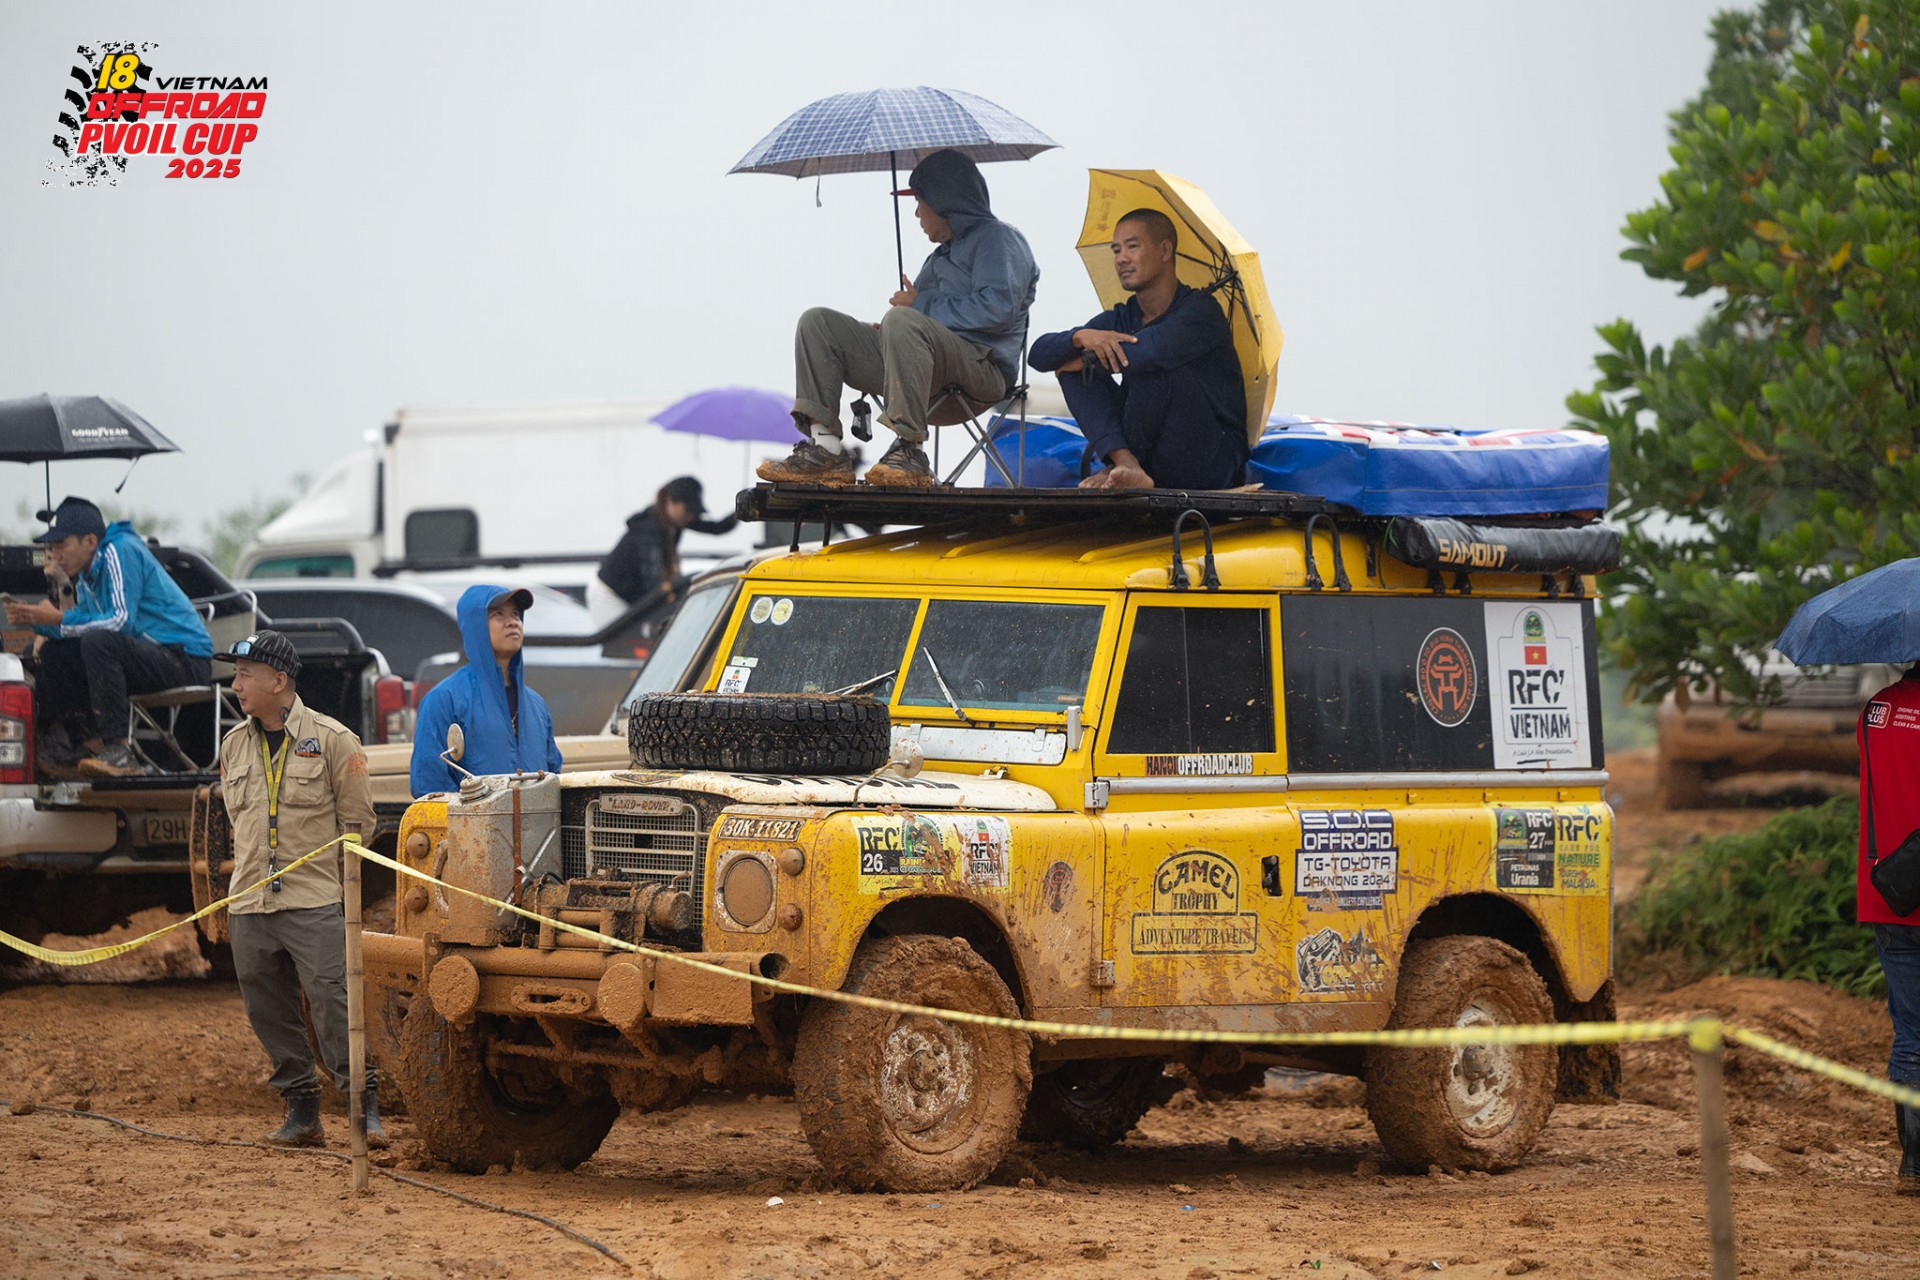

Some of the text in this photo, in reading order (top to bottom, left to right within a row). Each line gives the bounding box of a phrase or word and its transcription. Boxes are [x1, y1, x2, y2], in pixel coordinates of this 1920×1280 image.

[1438, 538, 1508, 568] SAMOUT
[1511, 713, 1571, 738] VIETNAM
[1302, 811, 1393, 829] S.O.C
[1303, 832, 1392, 850] OFFROAD
[1529, 832, 1546, 849] 27
[863, 853, 884, 873] 26
[1304, 856, 1391, 871] TG-TOYOTA
[1558, 853, 1600, 865] NATURE
[1158, 860, 1235, 900] CAMEL
[1362, 875, 1390, 886] 2024
[1511, 873, 1539, 886] Urania
[1172, 893, 1219, 910] TROPHY
[1139, 928, 1201, 945] ADVENTURE
